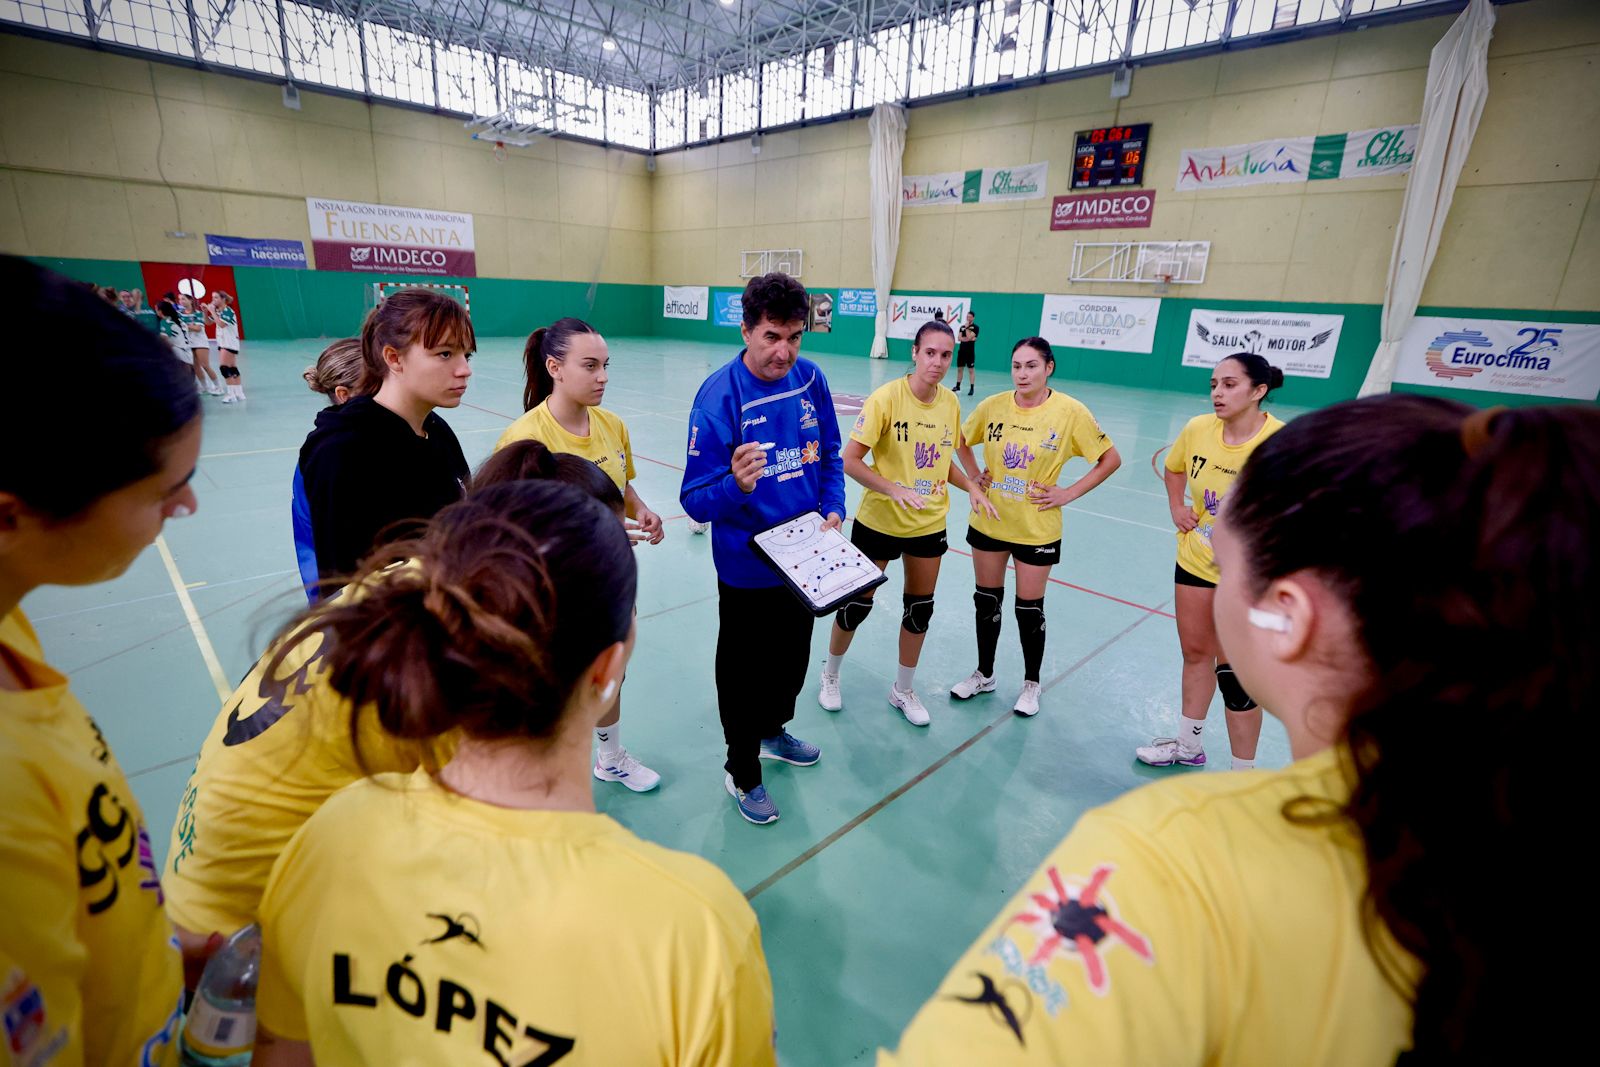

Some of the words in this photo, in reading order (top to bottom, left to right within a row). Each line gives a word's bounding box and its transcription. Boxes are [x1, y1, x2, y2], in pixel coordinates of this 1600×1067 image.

[1126, 151, 1140, 165] 06
[1180, 146, 1300, 183] Andalucía
[902, 179, 959, 201] ndalucía
[315, 200, 375, 215] INSTALACIÓN
[378, 207, 423, 220] DEPORTIVA
[424, 212, 466, 224] MUNICIPAL
[1075, 196, 1151, 216] IMDECO
[325, 211, 461, 247] FUENSANTA
[251, 248, 305, 261] hacemos
[373, 247, 446, 266] IMDECO
[666, 300, 699, 315] efficold
[911, 305, 942, 314] SALMA
[1079, 303, 1117, 313] CÓRDOBA
[1059, 311, 1137, 329] IGUALDAD
[1086, 327, 1121, 336] DEPORTE
[1212, 334, 1238, 347] SALU
[1512, 327, 1563, 355] 25
[1267, 337, 1306, 351] MOTOR
[1451, 347, 1551, 371] Euroclima
[893, 421, 908, 442] 11
[987, 422, 1004, 441] 14
[1190, 455, 1207, 479] 17
[991, 481, 1025, 495] anarias
[332, 953, 576, 1067] LÓPEZ
